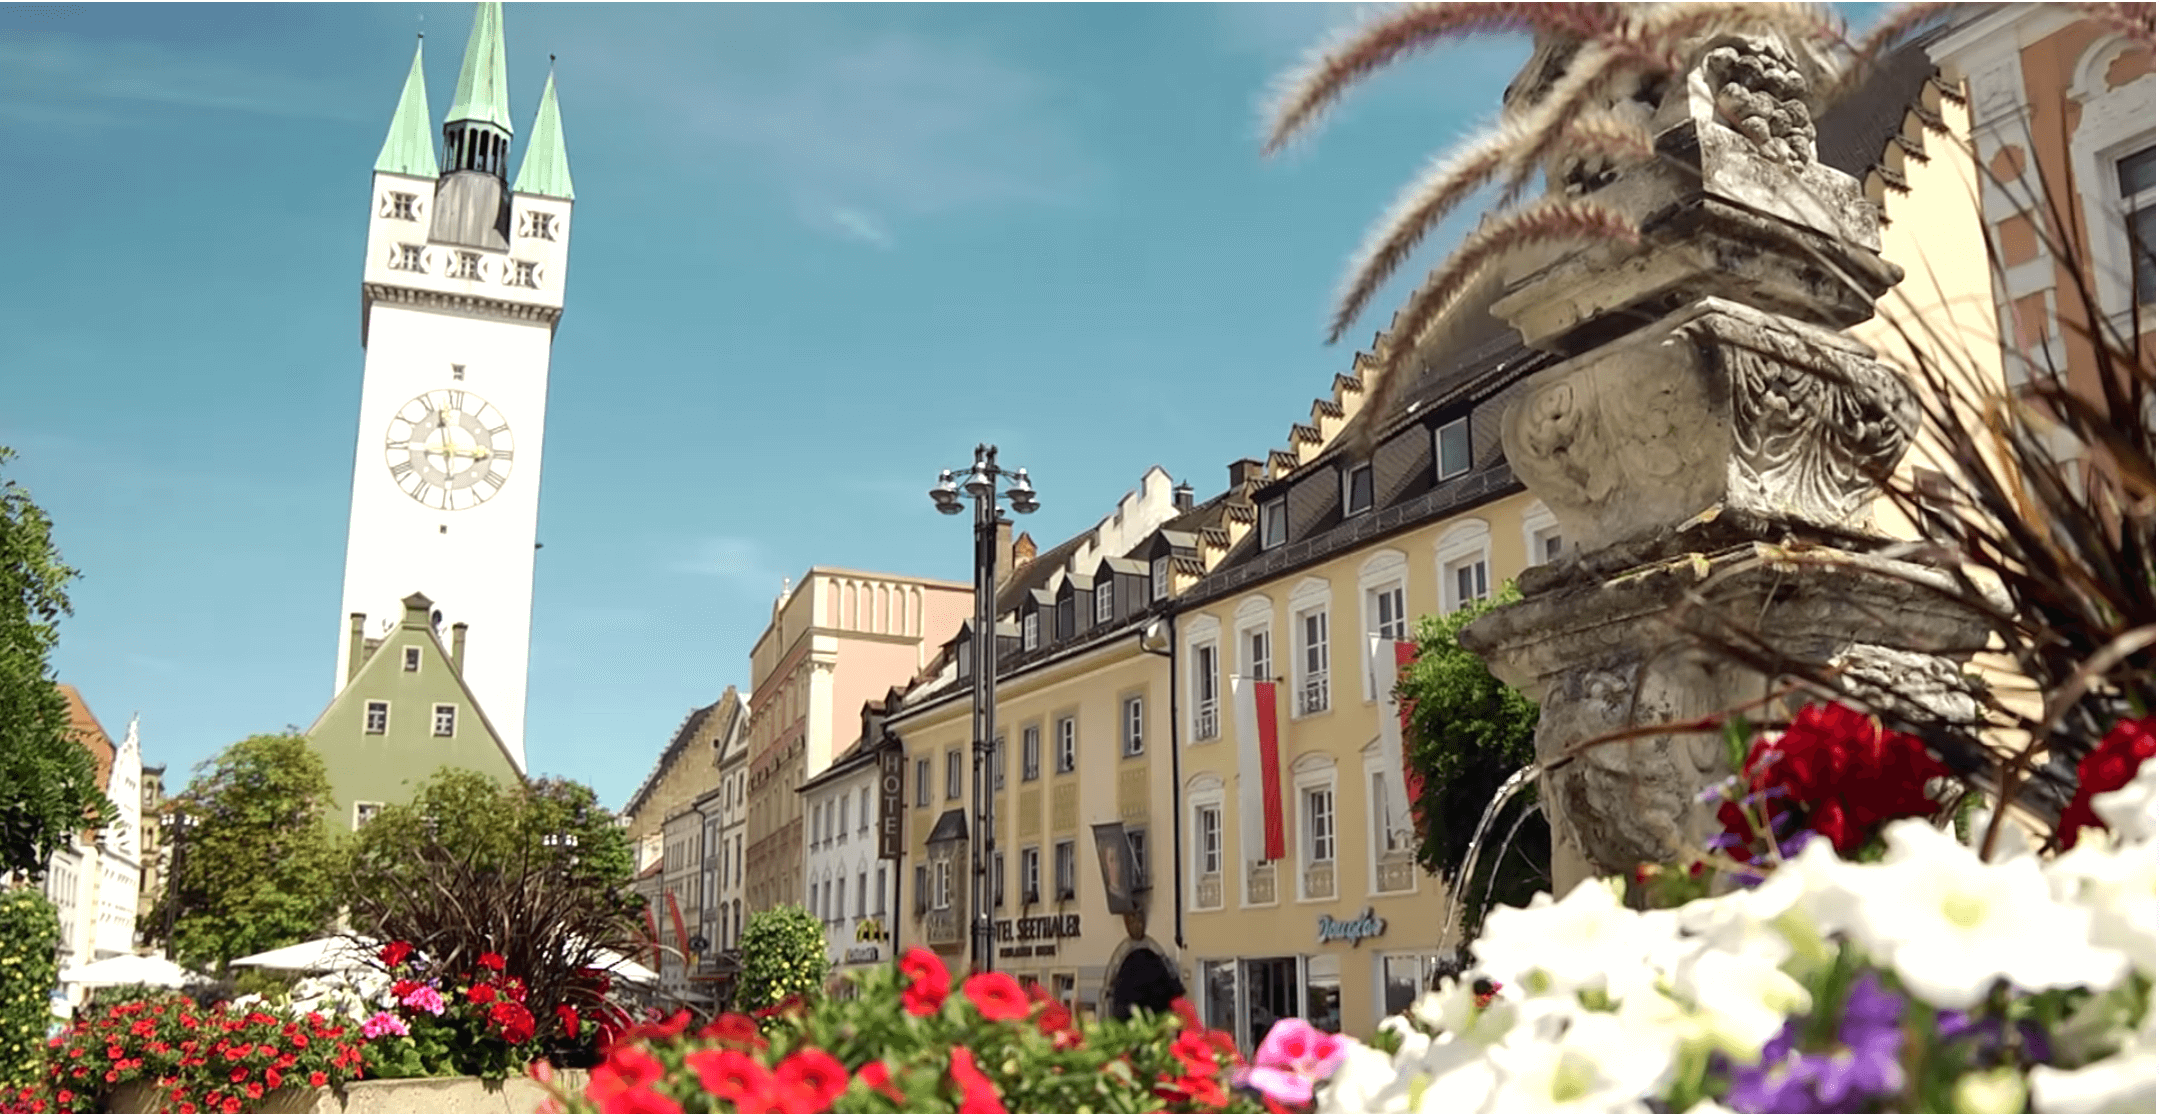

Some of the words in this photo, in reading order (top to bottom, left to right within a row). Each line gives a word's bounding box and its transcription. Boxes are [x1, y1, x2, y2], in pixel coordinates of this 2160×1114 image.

[884, 756, 901, 855] HOTEL
[995, 919, 1014, 942] TEL
[1017, 914, 1081, 941] SEETHALER
